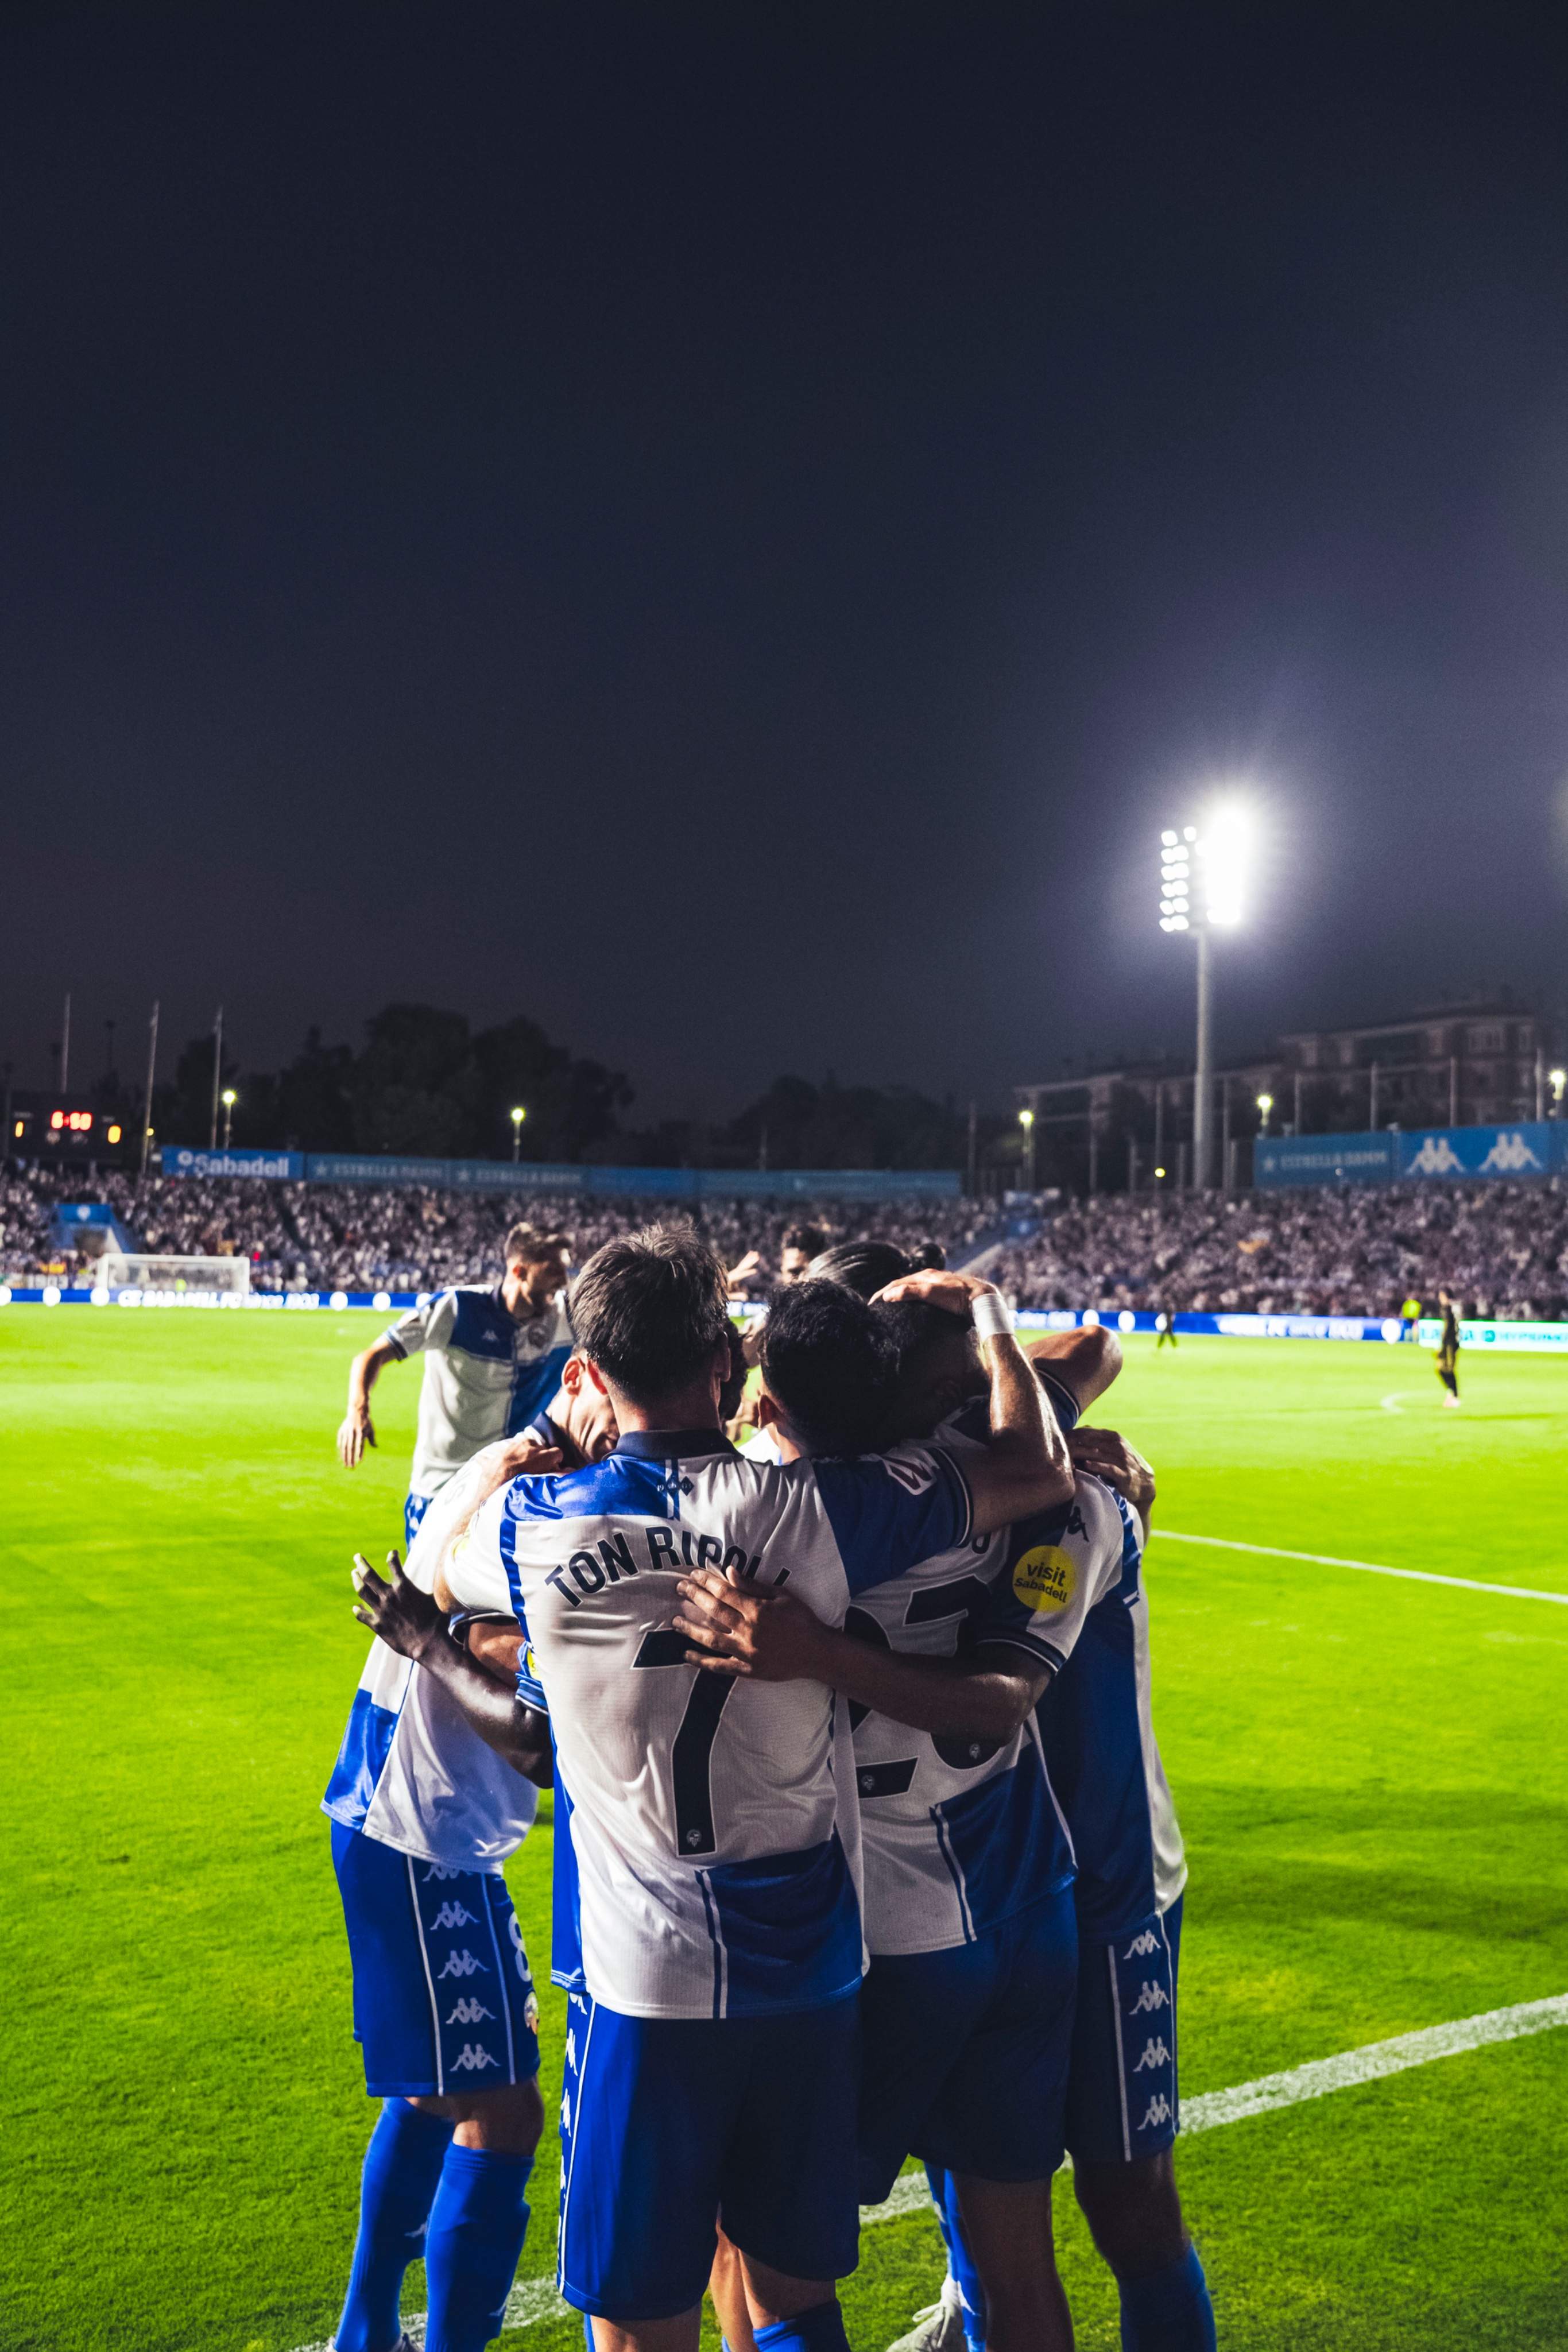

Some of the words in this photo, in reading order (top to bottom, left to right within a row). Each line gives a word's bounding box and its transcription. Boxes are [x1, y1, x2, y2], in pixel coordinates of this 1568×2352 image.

[194, 1154, 289, 1178] Sabadell
[544, 1531, 639, 1607] TON
[1027, 1562, 1066, 1587] visit
[1014, 1577, 1067, 1603] Sabadell
[630, 1628, 744, 1856] 7
